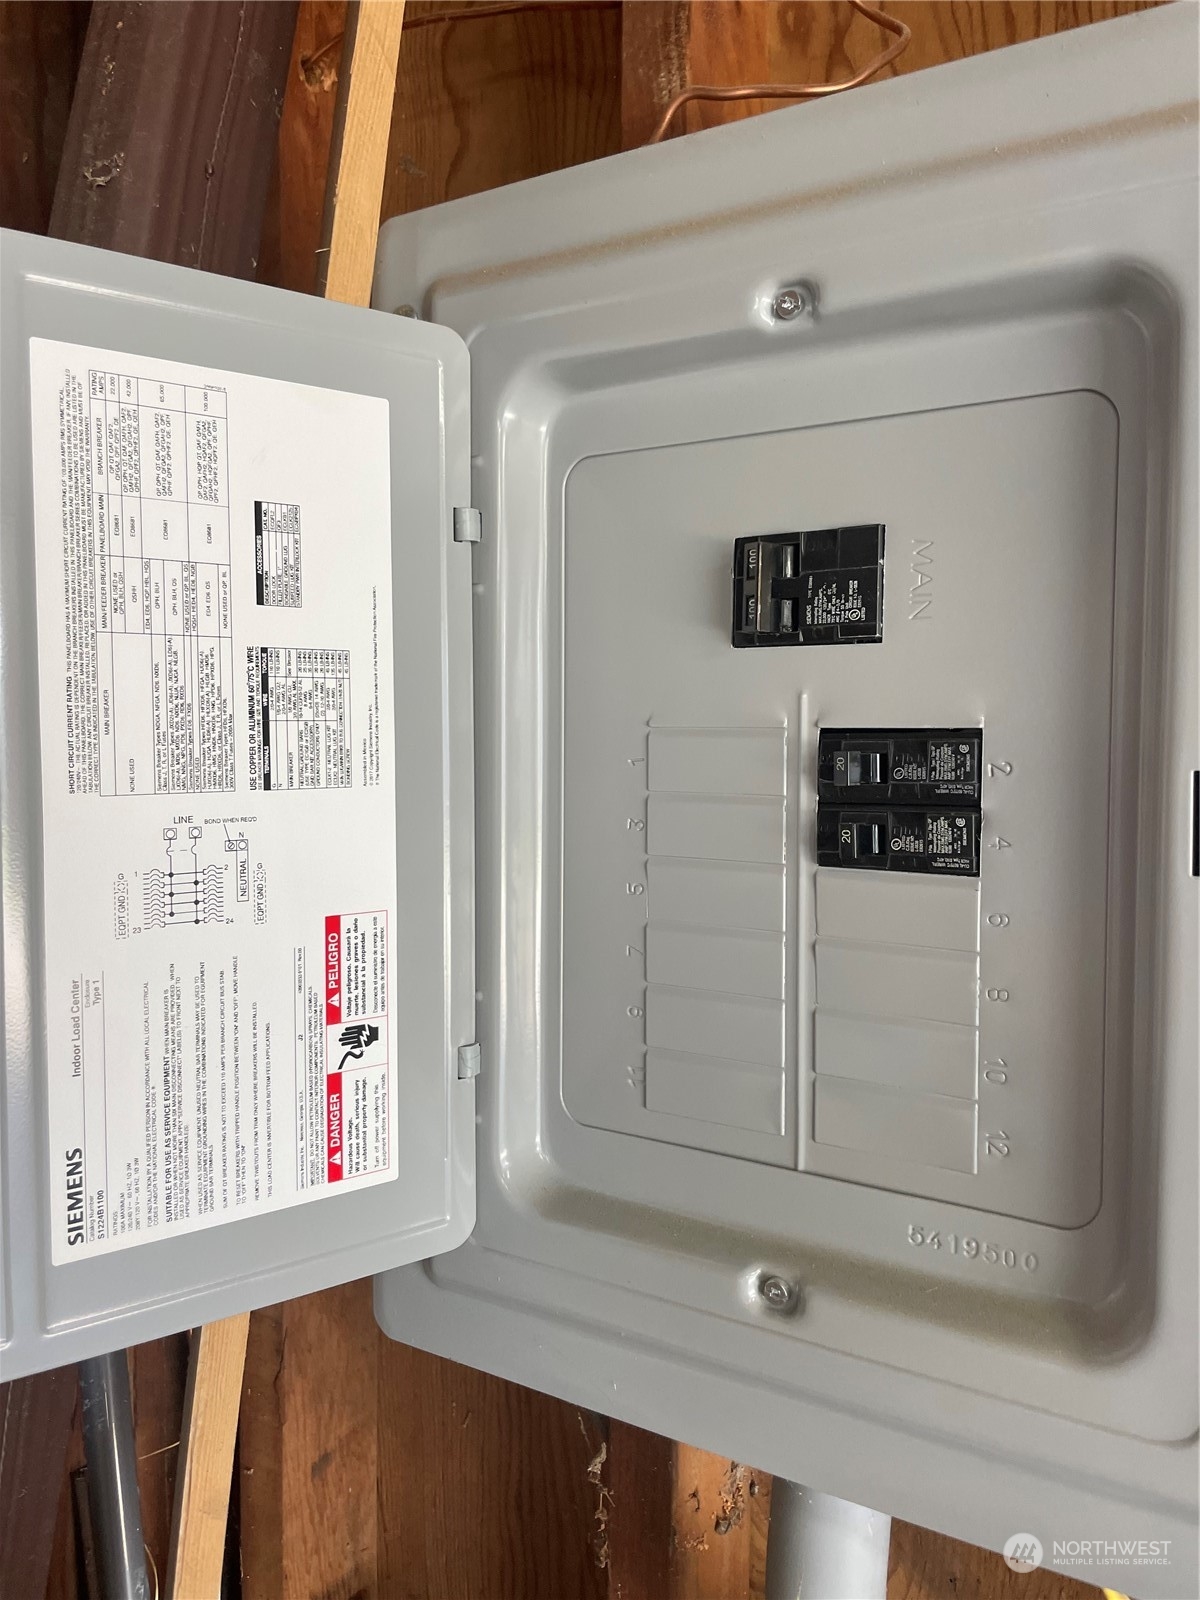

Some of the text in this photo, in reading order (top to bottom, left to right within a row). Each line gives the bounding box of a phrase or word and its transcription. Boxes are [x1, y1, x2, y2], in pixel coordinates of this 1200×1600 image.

[908, 540, 934, 620] MAIN
[247, 646, 257, 790] USE COPPER OR ALUMINUM 60°/75°C WIRE
[628, 758, 644, 766] 1
[836, 757, 845, 770] 20
[988, 762, 1011, 777] 2
[174, 816, 193, 824] LINE
[627, 818, 644, 831] 3
[842, 830, 850, 843] 20
[988, 838, 1011, 850] 4
[626, 883, 644, 895] 5
[987, 913, 1009, 927] 6
[626, 945, 643, 956] 7
[328, 933, 339, 988] PELIGRO
[92, 986, 101, 1005] Type
[986, 988, 1009, 1001] 8
[627, 1006, 643, 1018] 9
[70, 980, 82, 1077] Indoor Load Center
[163, 1056, 171, 1101] EQUIPMENT
[627, 1066, 644, 1088] 11
[984, 1058, 1008, 1084] 10
[164, 1103, 172, 1136] SERVICE
[330, 1093, 340, 1147] DANGER
[164, 1137, 172, 1148] AS
[986, 1130, 1008, 1156] 12
[66, 1148, 84, 1245] SIEMENS
[165, 1185, 173, 1222] SUITABLE
[907, 1224, 1038, 1272] 5419500
